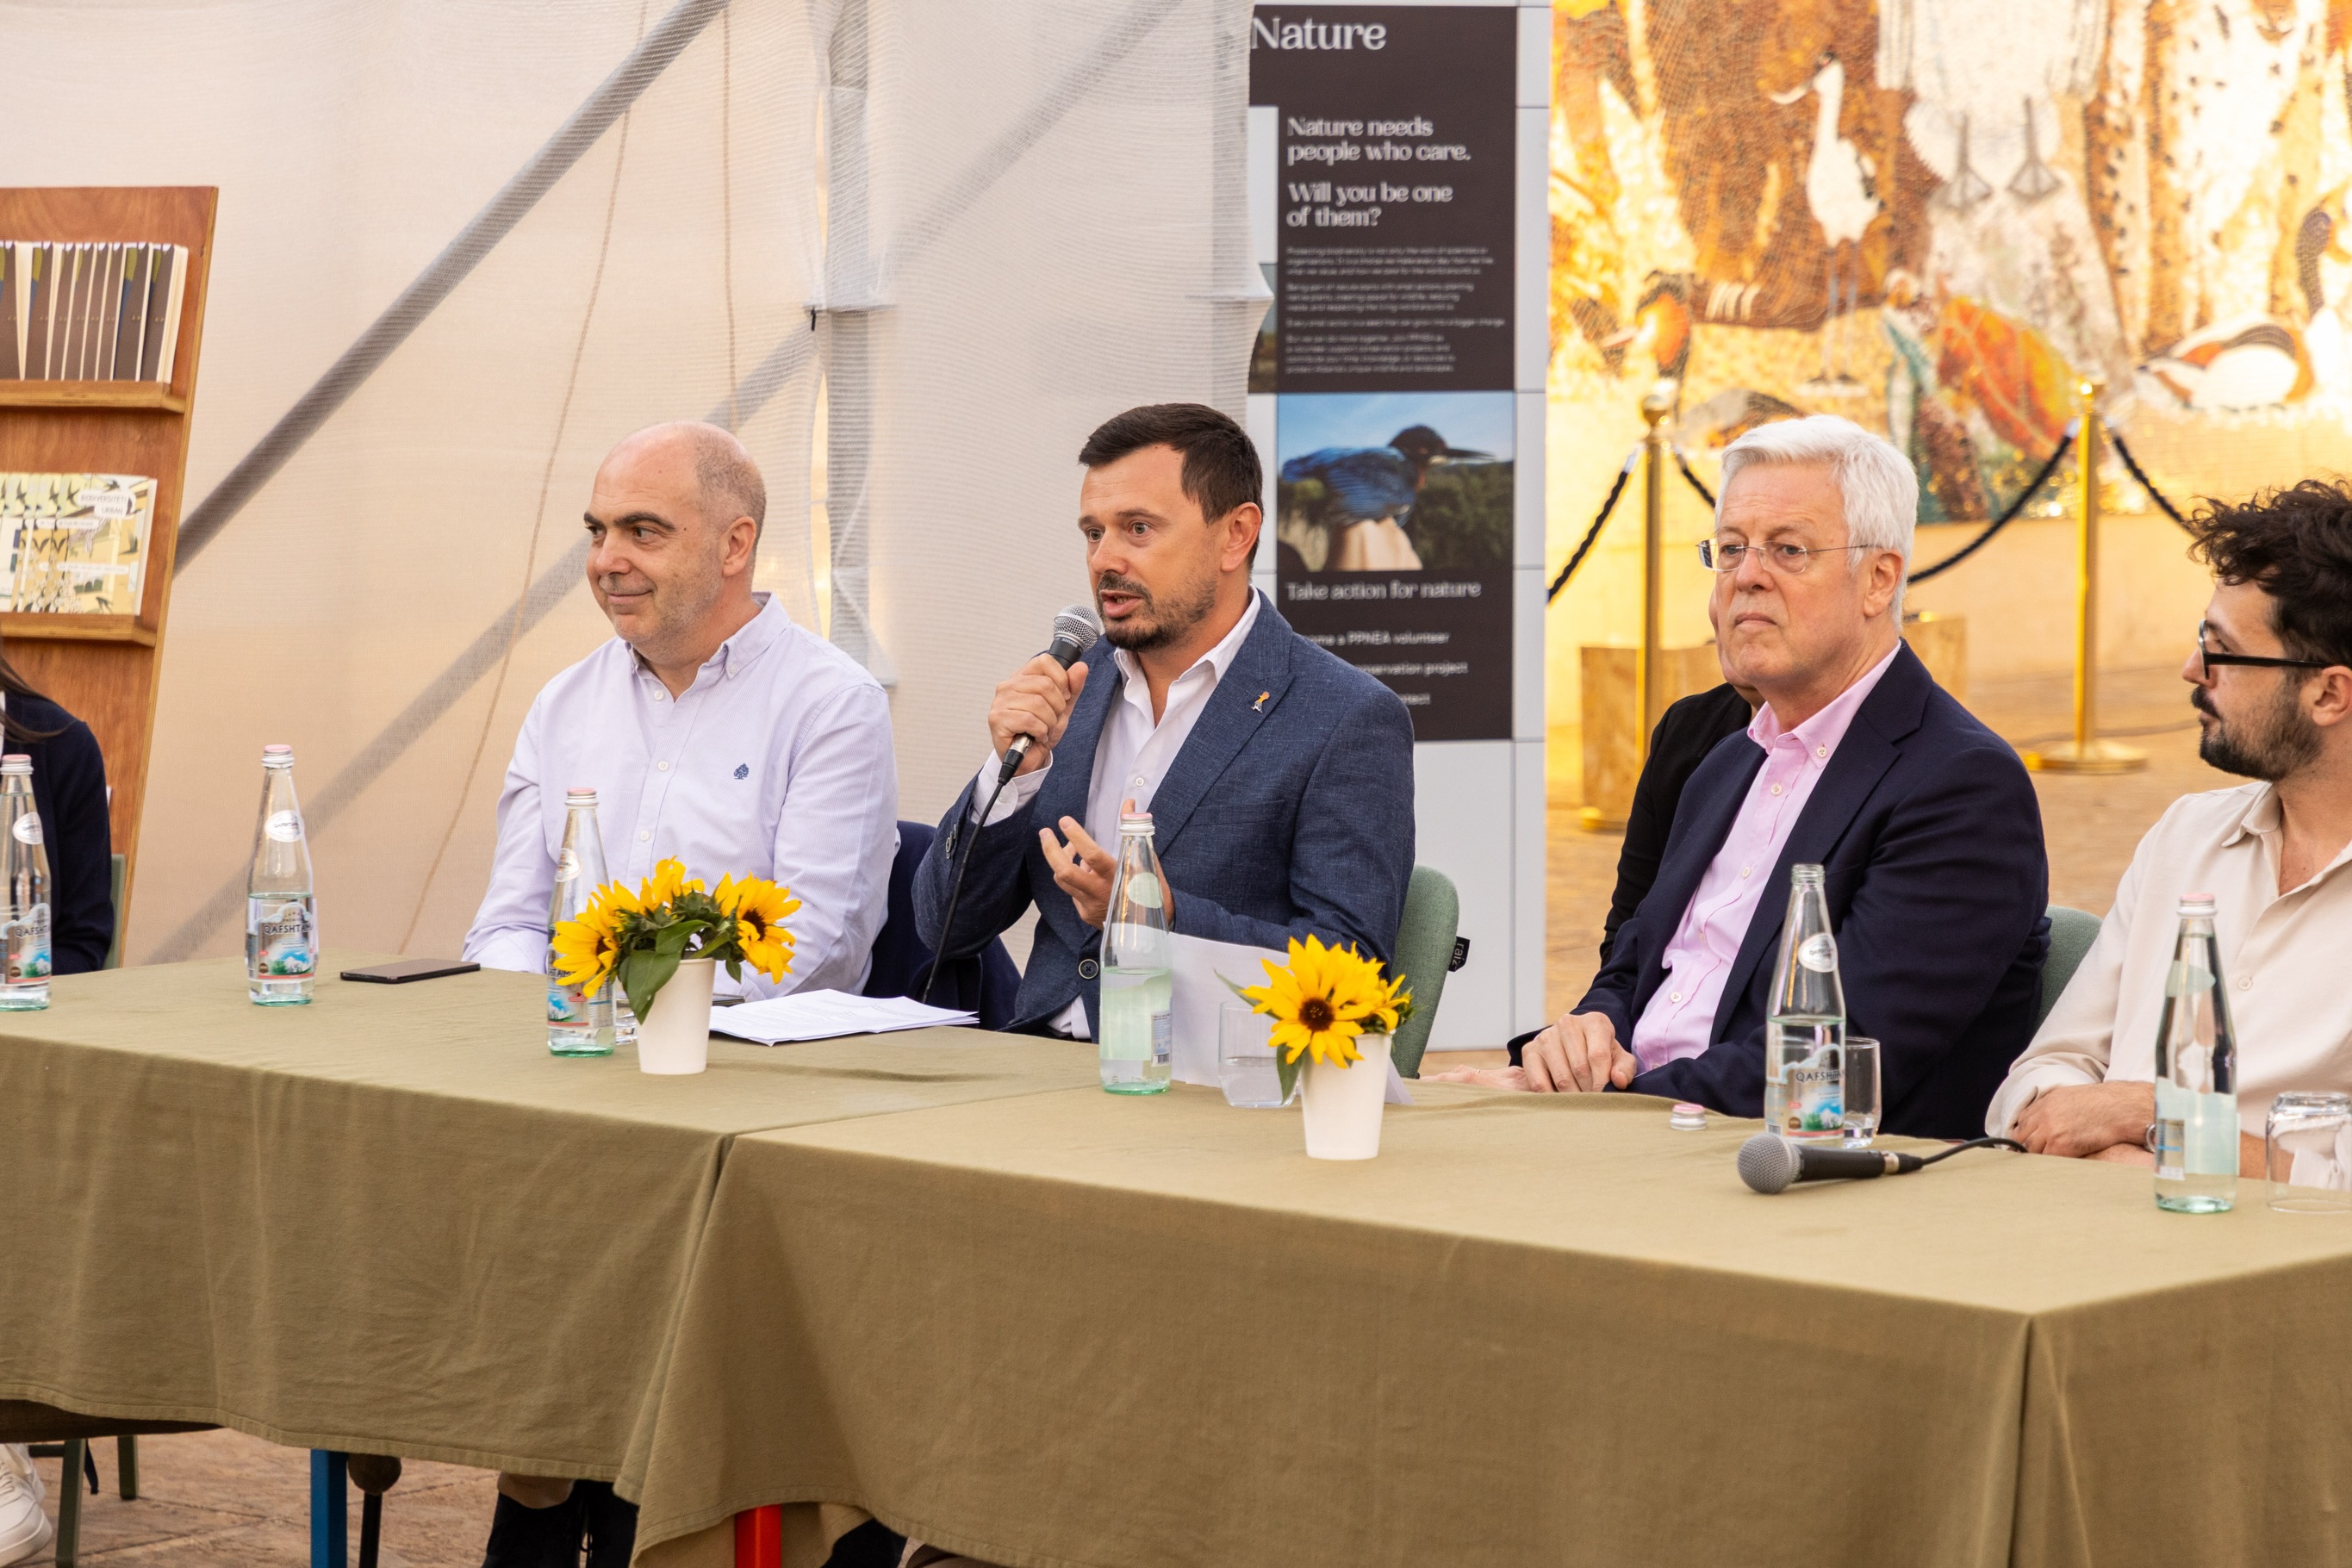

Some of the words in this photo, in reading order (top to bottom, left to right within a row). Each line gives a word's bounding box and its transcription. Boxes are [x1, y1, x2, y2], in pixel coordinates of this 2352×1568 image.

[1251, 16, 1387, 50] Nature
[1287, 117, 1364, 137] Nature
[1367, 115, 1434, 137] needs
[1287, 140, 1361, 166] people
[1365, 140, 1413, 161] who
[1416, 143, 1472, 161] care.
[1287, 182, 1332, 202] Will
[1335, 186, 1377, 208] you
[1380, 182, 1409, 202] be
[1412, 185, 1454, 202] one
[1286, 206, 1311, 227] of
[1315, 206, 1382, 227] them?
[1286, 581, 1329, 600] Take
[1330, 581, 1387, 600] action
[1390, 579, 1419, 599] for
[1421, 581, 1482, 599] nature
[1392, 630, 1451, 645] volunteer
[1423, 660, 1470, 678] project
